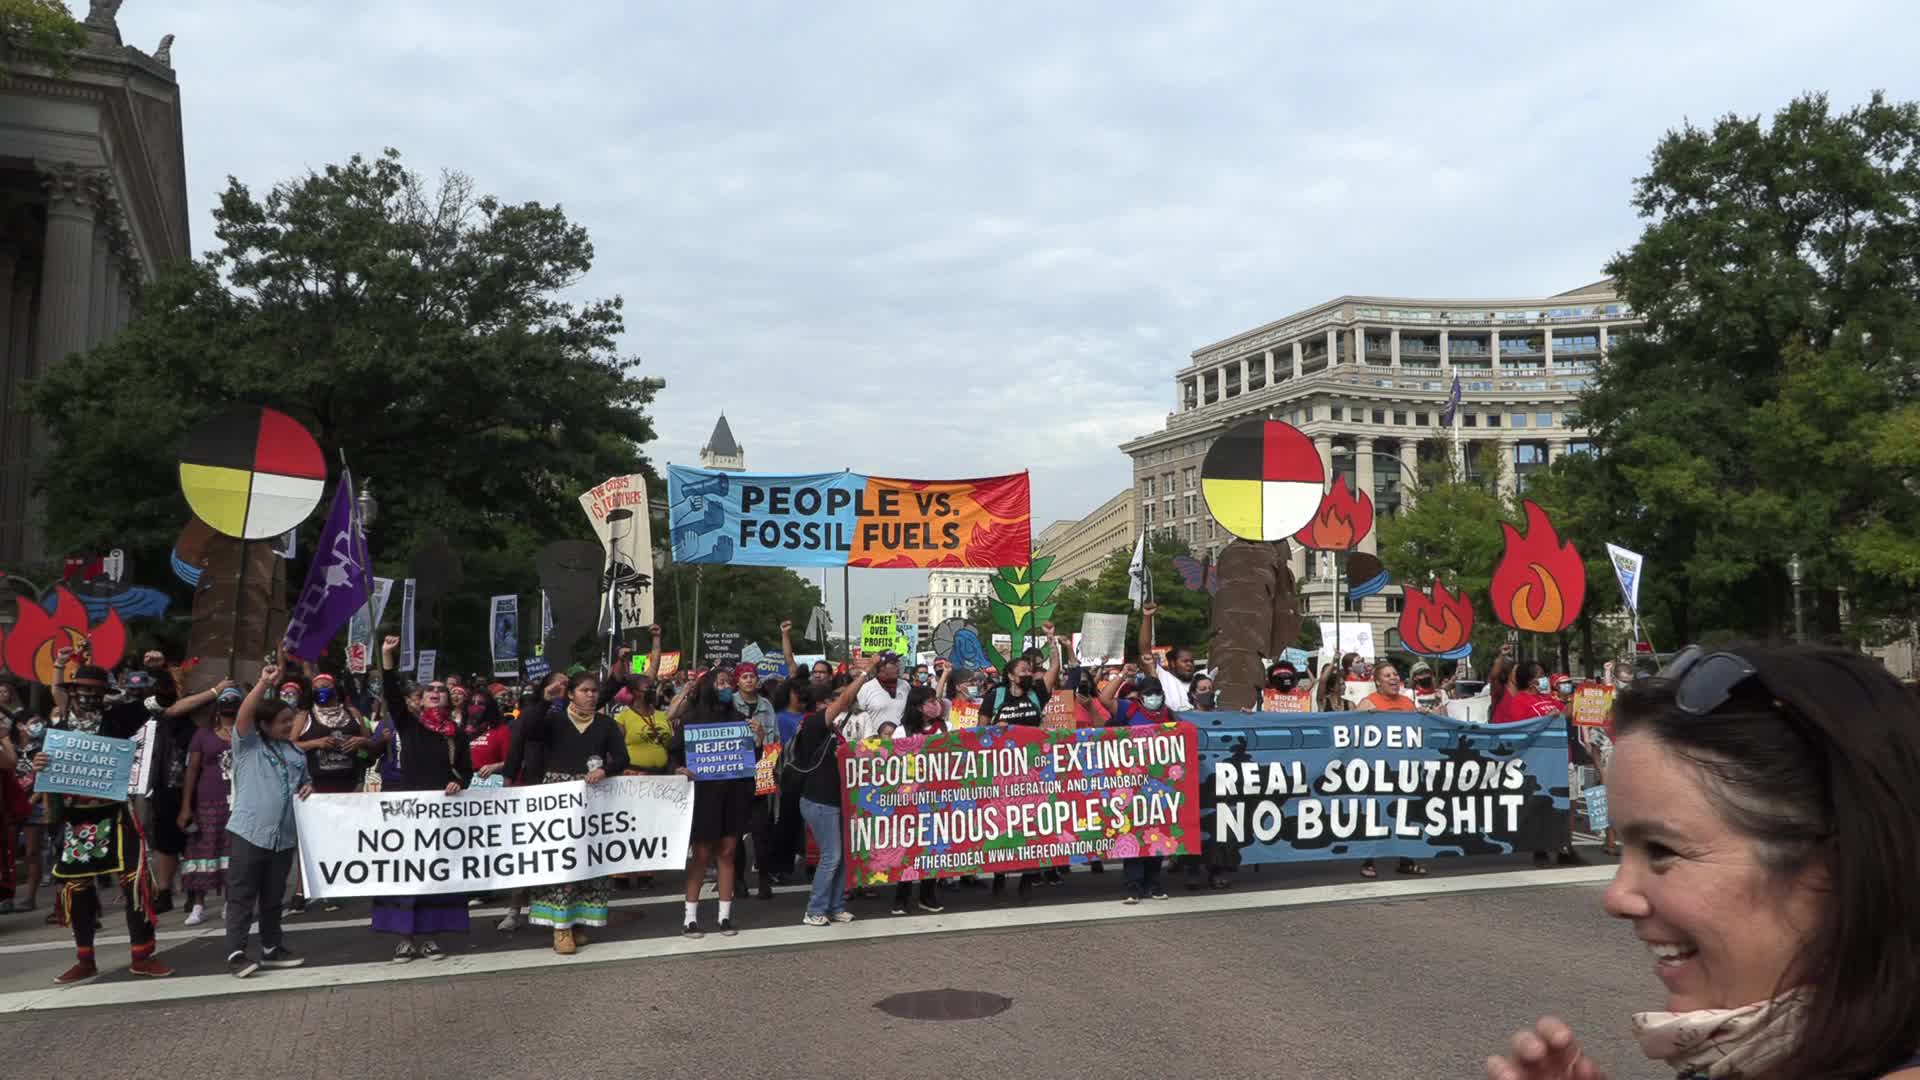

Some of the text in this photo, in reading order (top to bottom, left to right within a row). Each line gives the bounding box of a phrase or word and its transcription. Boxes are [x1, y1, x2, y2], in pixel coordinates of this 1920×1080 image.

[741, 486, 960, 517] PEOPLE VS.
[739, 519, 960, 551] FOSSIL FUELS
[866, 614, 892, 625] PLANET
[870, 626, 888, 635] OVER
[864, 637, 893, 647] PROFITS
[66, 737, 111, 753] BIDEN
[702, 728, 735, 739] BIDEN
[1333, 724, 1423, 748] BIDEN
[55, 749, 117, 767] DECLARE
[695, 740, 742, 753] REJECT
[696, 755, 723, 763] FOSSIL
[697, 763, 744, 773] PROJECTS
[845, 735, 1186, 789] DECOLONIZATION OR EXTINCTION
[49, 775, 113, 790] EMERGENCY
[52, 763, 114, 780] CLIMATE
[1215, 758, 1524, 796] REAL SOLUTIONS
[879, 792, 911, 807] BUILD
[912, 790, 940, 805] UNTIL
[1067, 778, 1088, 792] AND
[1091, 773, 1150, 790] #LANDBACK
[380, 798, 418, 821] FUCK
[415, 792, 588, 820] PRESIDENT BIDEN,
[850, 791, 1181, 853] INDIGENOUS PEOPLE'S DAY
[1216, 794, 1524, 843] NO BULLSHIT
[358, 810, 637, 853] NO MORE EXCUSES:
[319, 836, 668, 885] VOTING RIGHTS NOW!
[914, 838, 1116, 870] #THEREDDEAL WWW.THEREDNATION.ORG
